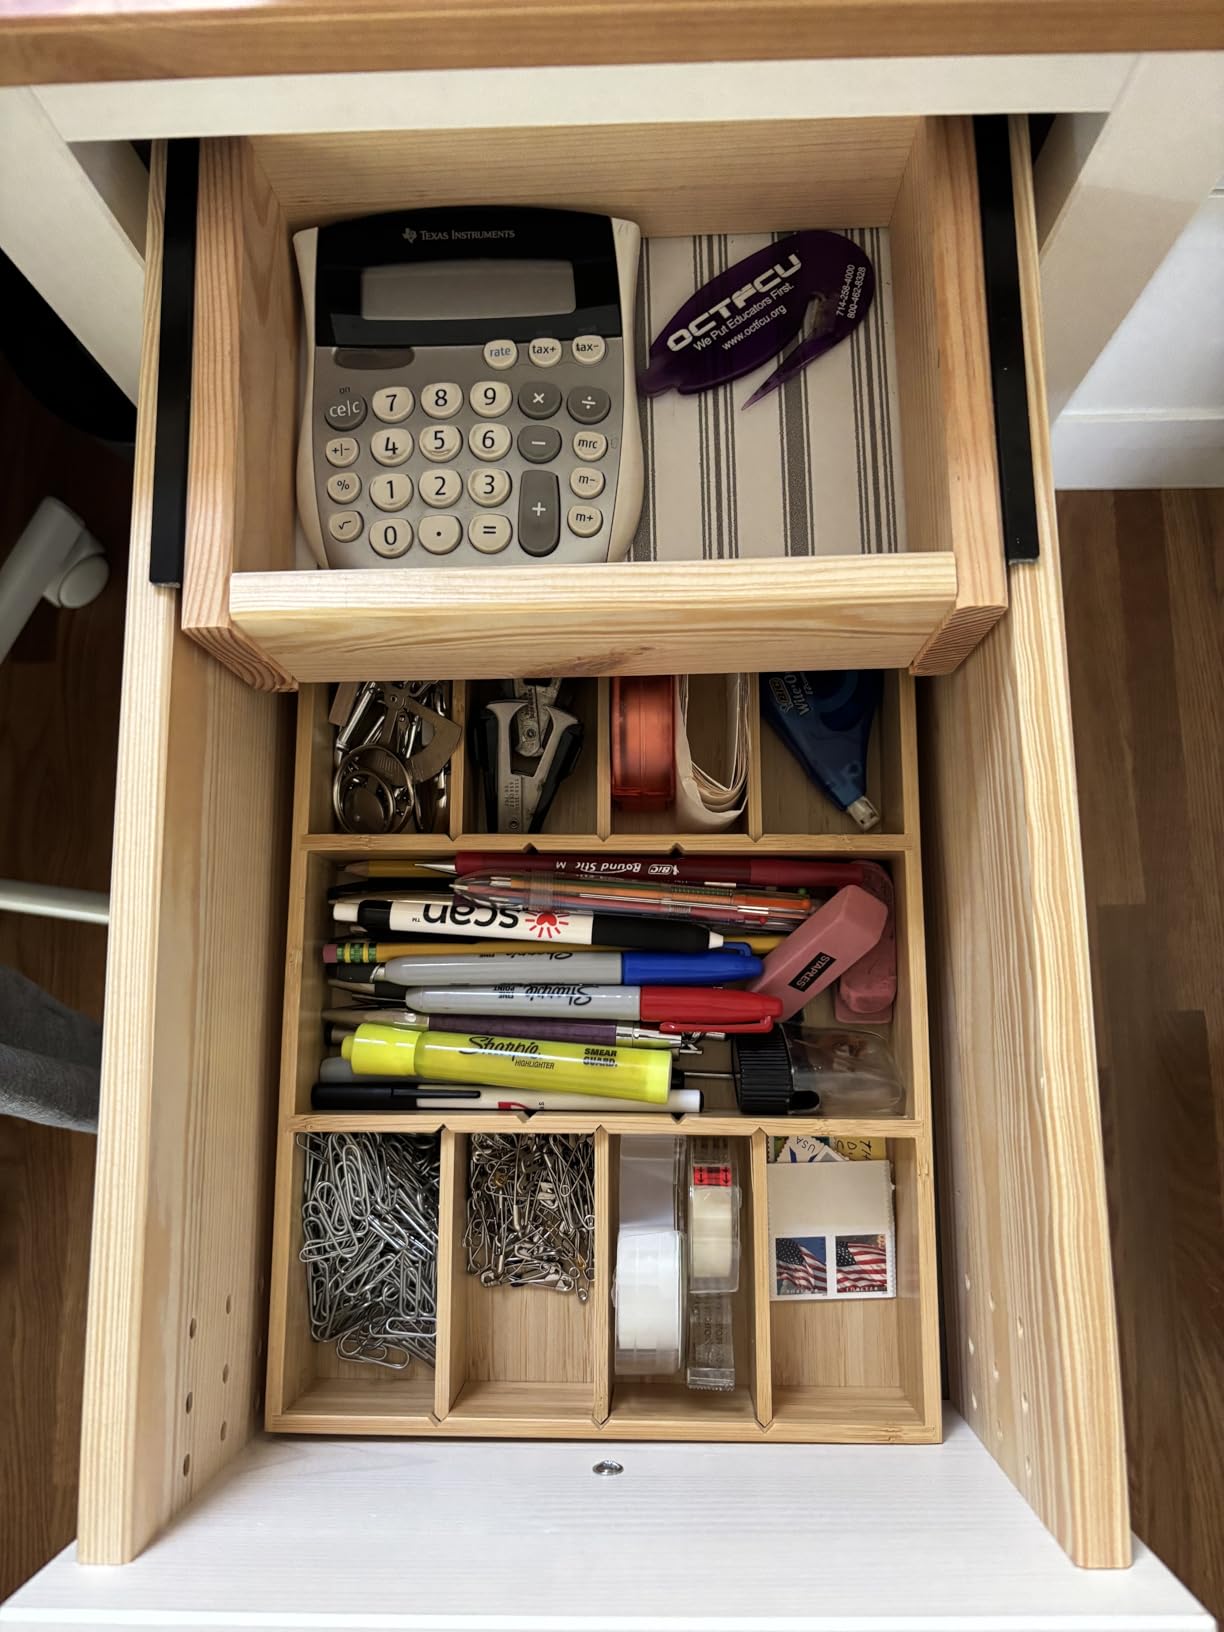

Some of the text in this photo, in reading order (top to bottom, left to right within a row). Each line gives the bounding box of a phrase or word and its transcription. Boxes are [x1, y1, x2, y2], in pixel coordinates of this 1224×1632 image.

[420, 229, 516, 240] TEXAS INSTRUMENTS
[836, 264, 856, 317] 714-258-4000
[846, 266, 867, 319] 800-462-8328
[666, 253, 802, 352] OCTFCU
[693, 282, 795, 352] We Put Educators First.
[721, 304, 788, 351] www.octfcu.org
[489, 346, 511, 358] rate
[532, 344, 557, 355] tax+
[339, 386, 351, 394] on
[434, 389, 448, 407] 8
[483, 387, 497, 406] 9
[385, 394, 398, 412] 7
[384, 437, 398, 455] 4
[433, 430, 445, 450] 5
[482, 429, 495, 449] 6
[578, 438, 598, 450] mrc
[336, 480, 350, 491] %
[434, 477, 446, 496] 2
[483, 475, 495, 495] 3
[578, 474, 596, 485] m-
[386, 480, 395, 499] 1
[575, 513, 594, 523] m+
[383, 526, 398, 546] 0
[555, 861, 567, 869] M
[575, 862, 598, 874] Stic
[600, 862, 642, 874] Round
[422, 903, 520, 929] scan
[796, 955, 831, 988] STAPLES
[524, 984, 600, 1006] Sharpie
[459, 1035, 541, 1062] Sharpie
[584, 1048, 618, 1057] SMEAR
[514, 1060, 555, 1070] HIGHLIGHTER
[796, 1136, 816, 1153] USA
